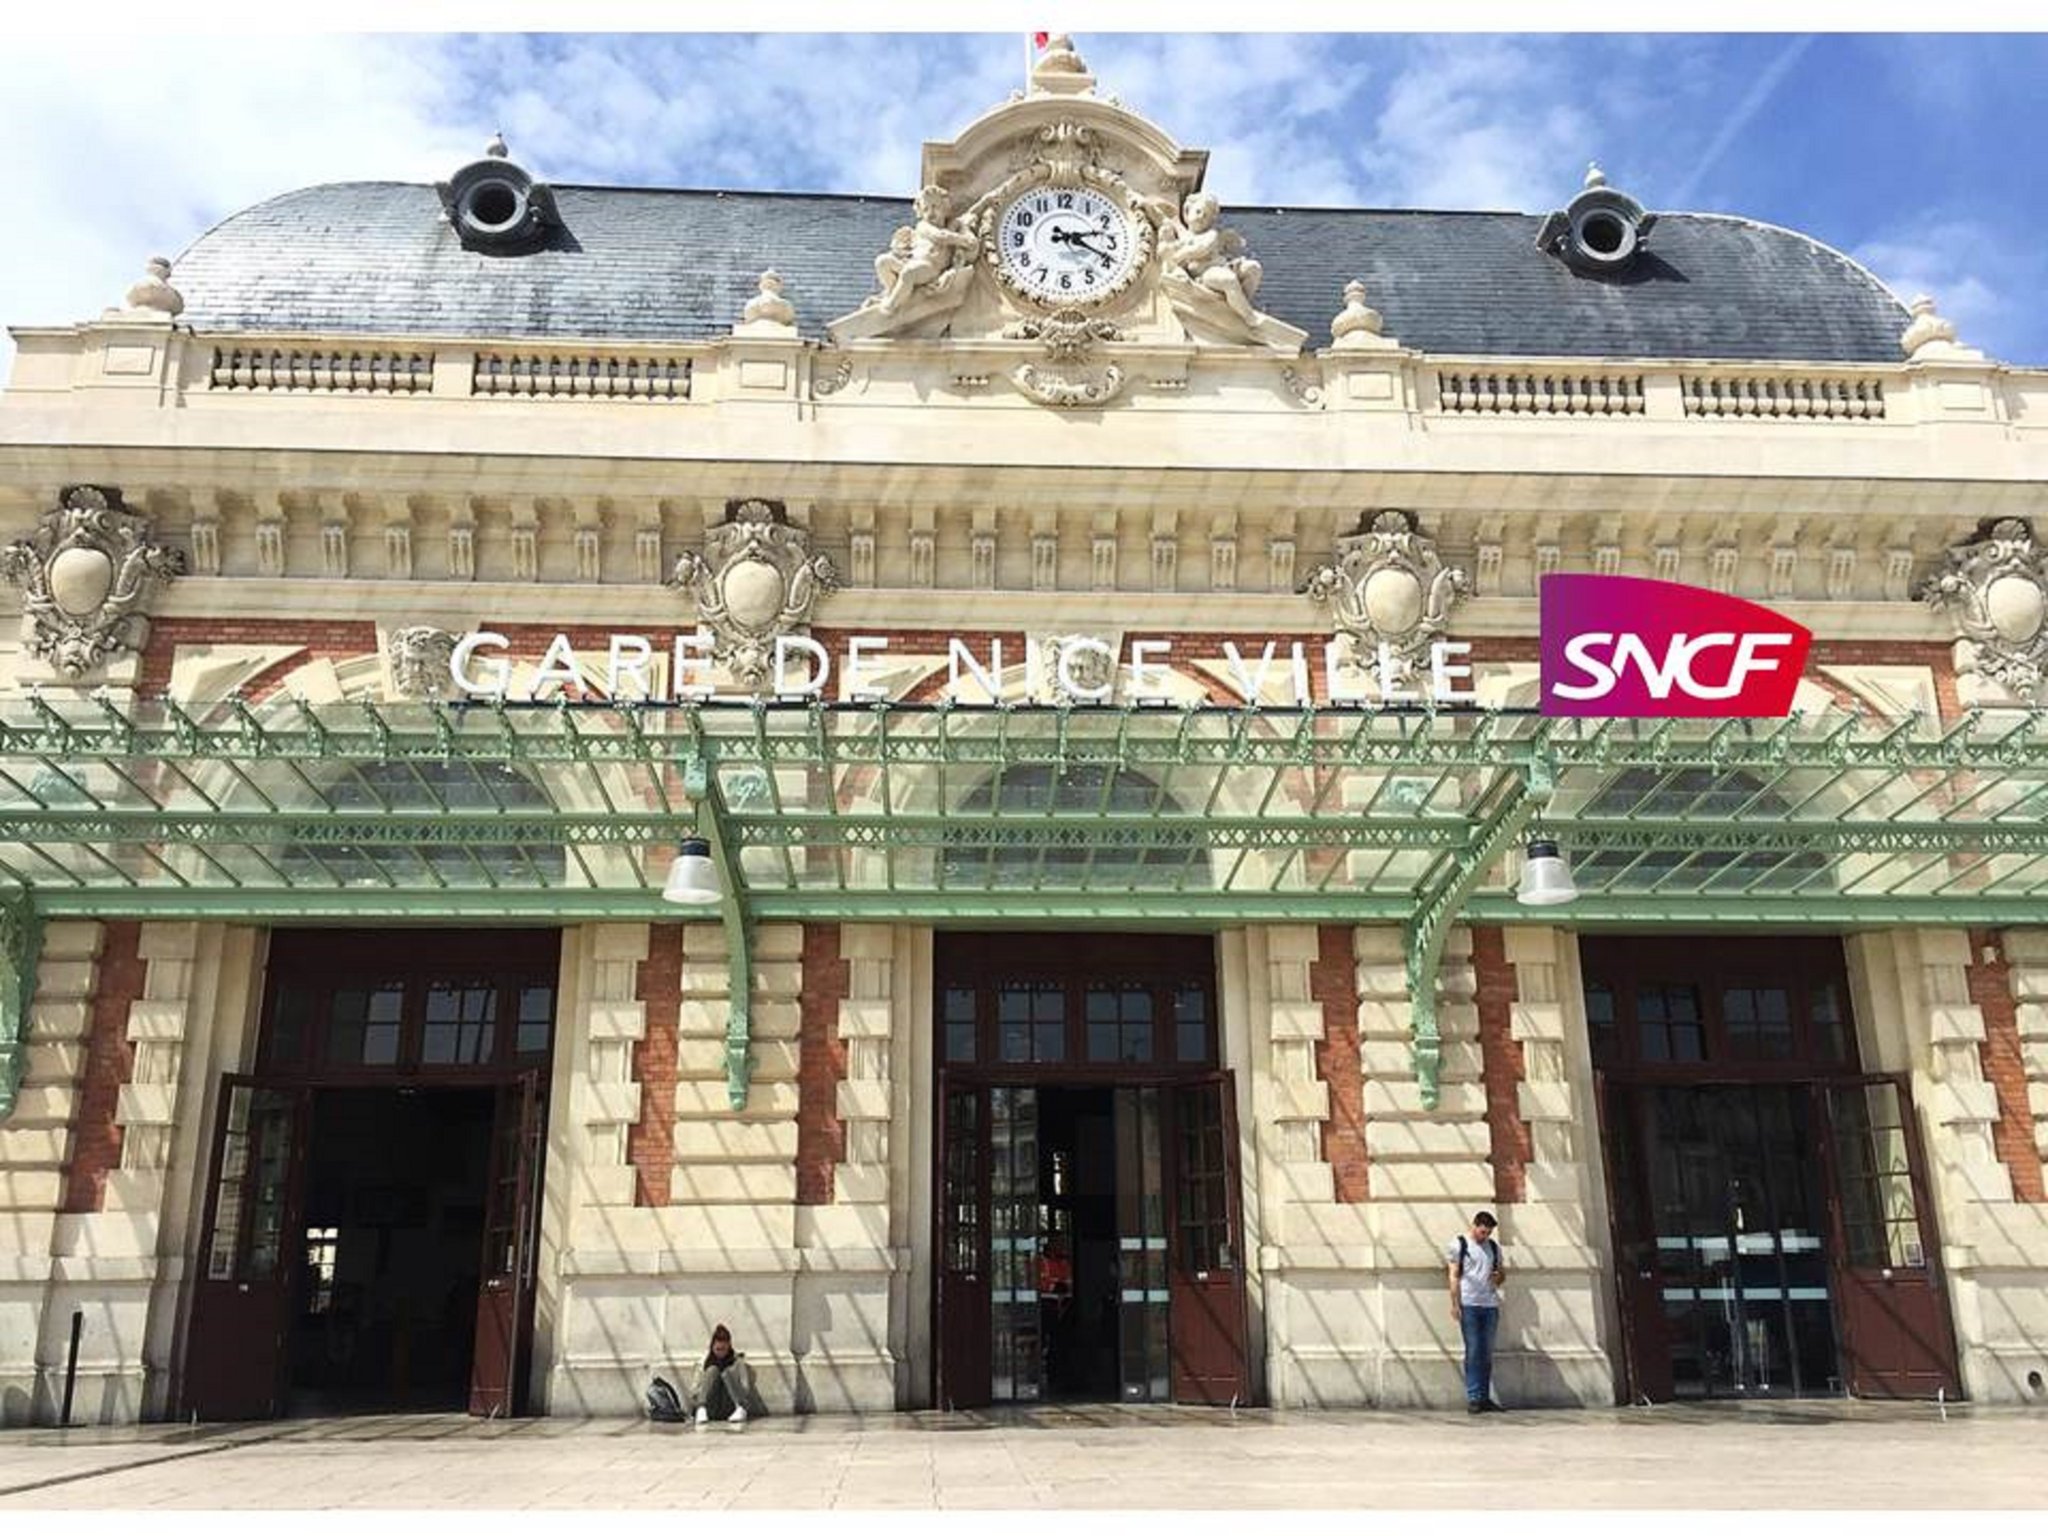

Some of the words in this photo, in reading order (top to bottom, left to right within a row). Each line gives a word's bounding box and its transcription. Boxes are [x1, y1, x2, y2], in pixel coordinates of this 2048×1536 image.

[1037, 200, 1048, 212] 11
[1058, 194, 1072, 209] 12
[1086, 203, 1091, 215] 1
[1017, 213, 1033, 227] 10
[1100, 215, 1110, 230] 2
[1014, 232, 1024, 247] 9
[1107, 235, 1117, 250] 3
[1020, 252, 1031, 267] 8
[1101, 254, 1112, 270] 4
[1038, 268, 1048, 283] 7
[1061, 275, 1071, 289] 6
[1085, 270, 1095, 284] 5
[448, 631, 715, 697] GARE
[770, 634, 889, 698] DE
[945, 636, 1174, 701] NICE
[1224, 639, 1477, 703] VILLE
[1552, 631, 1793, 700] SNCF
